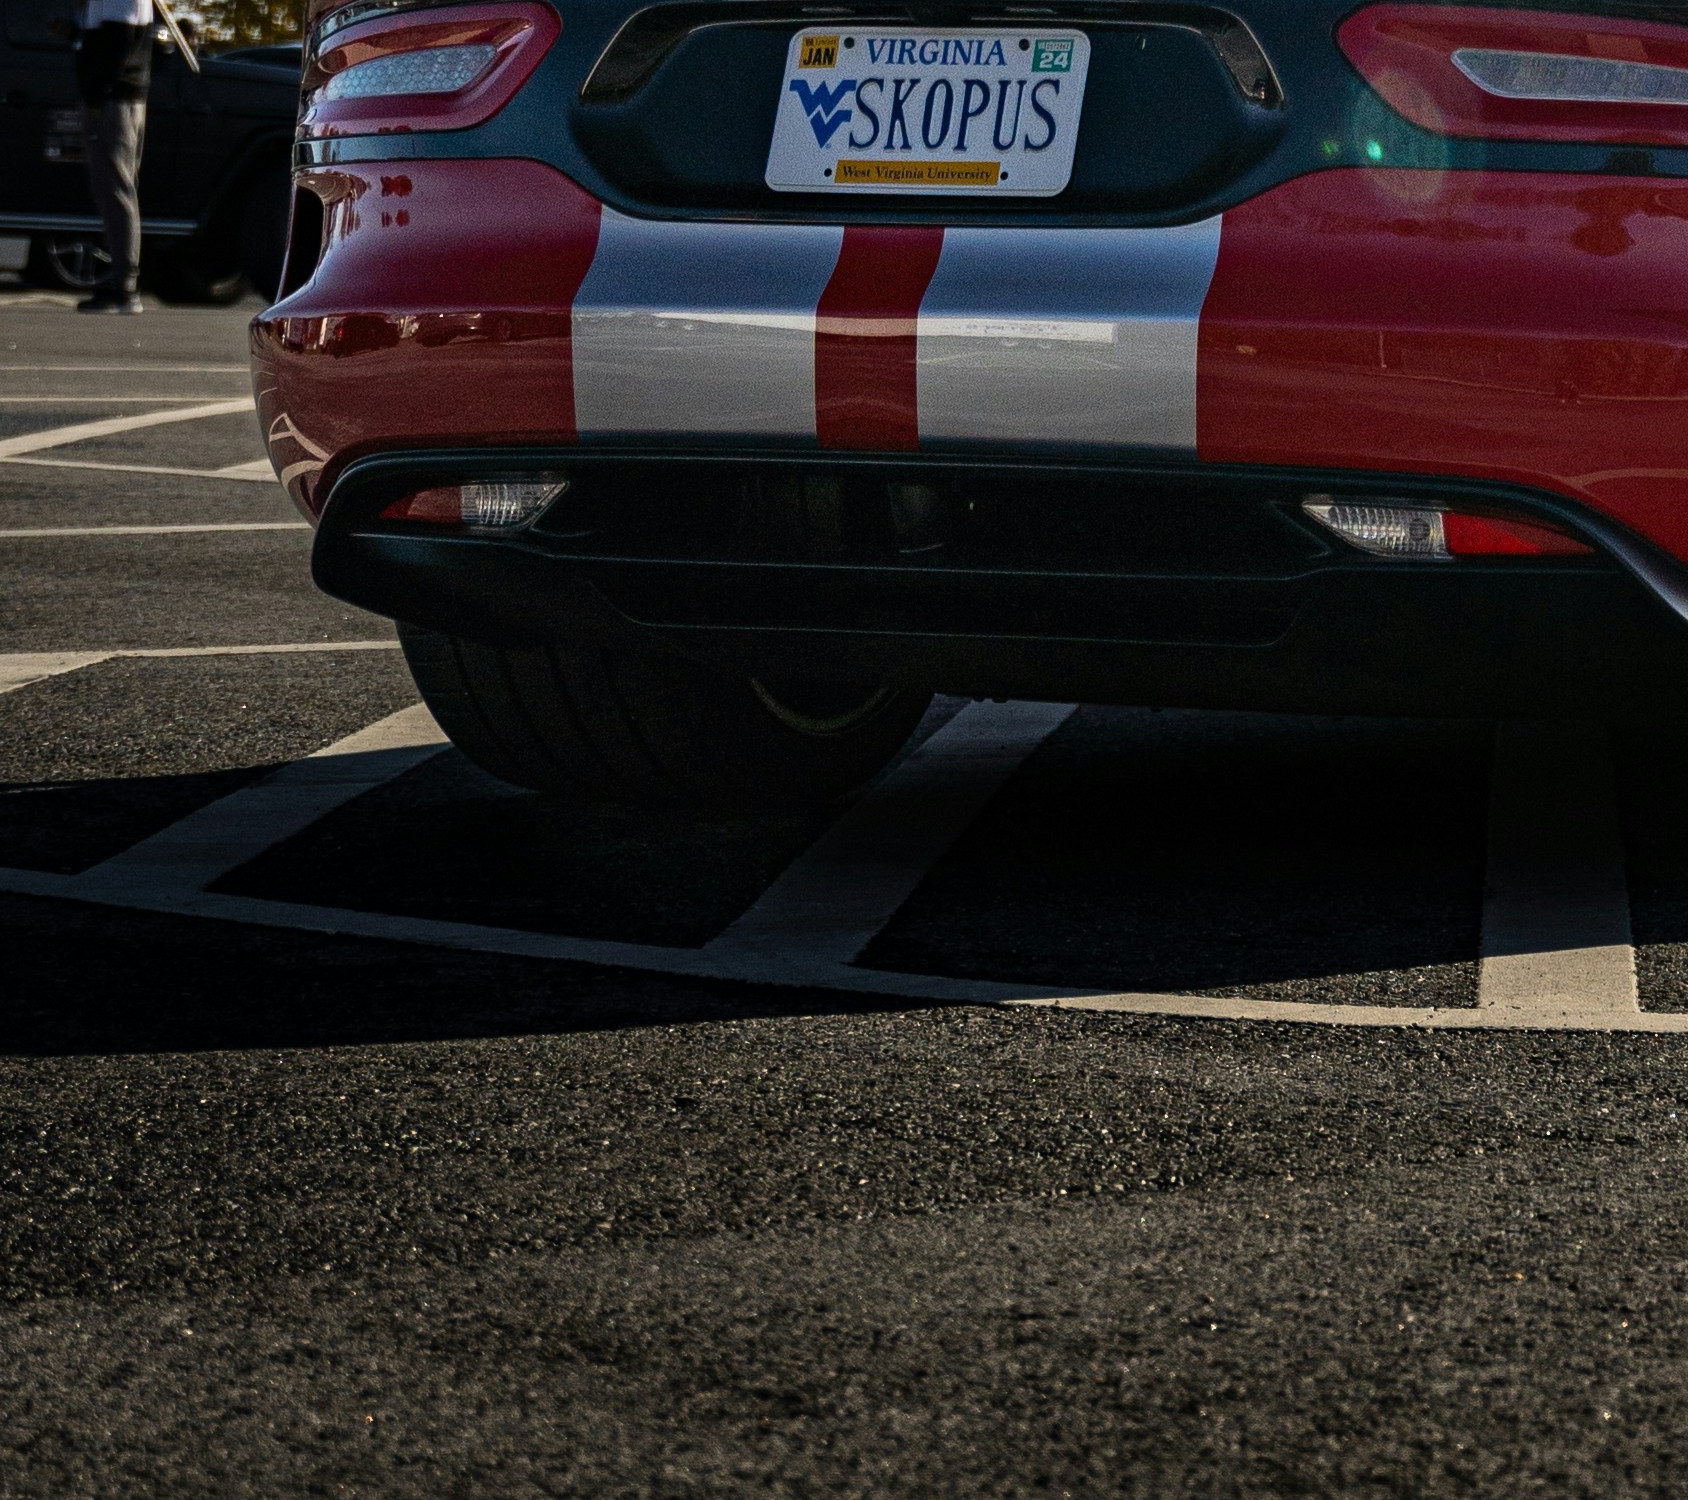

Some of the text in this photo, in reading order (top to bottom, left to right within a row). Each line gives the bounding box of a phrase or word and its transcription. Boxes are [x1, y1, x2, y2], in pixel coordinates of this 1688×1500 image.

[803, 47, 835, 66] JAN
[866, 38, 1007, 66] VIRGINIA
[1039, 52, 1069, 69] 24
[848, 77, 1061, 151] SKOPUS
[843, 165, 992, 182] West Virginia University
